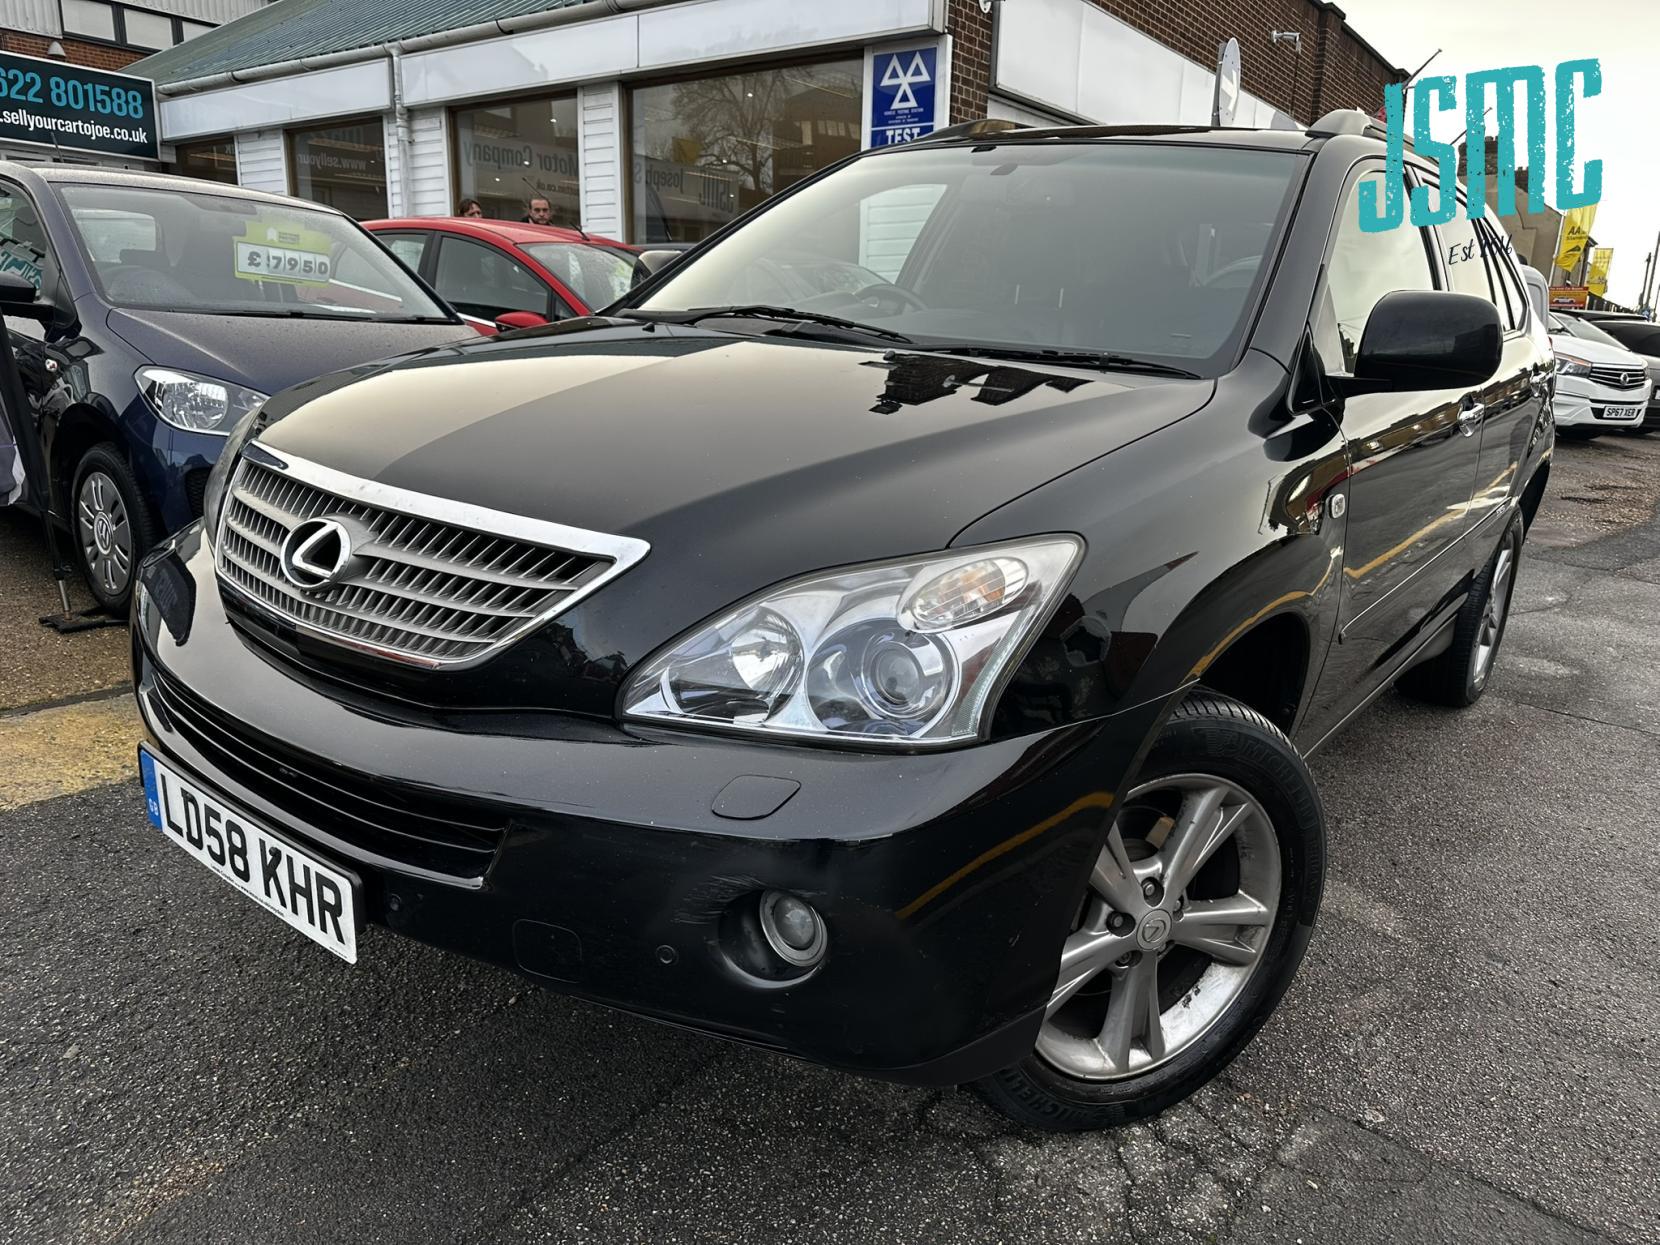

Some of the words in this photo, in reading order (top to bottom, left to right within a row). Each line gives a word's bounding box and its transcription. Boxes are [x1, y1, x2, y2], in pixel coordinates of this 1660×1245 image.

[49, 76, 144, 119] 801588
[886, 127, 920, 145] TEST
[1606, 407, 1623, 417] SP67
[161, 773, 250, 883] LD58
[259, 838, 345, 945] KHR
